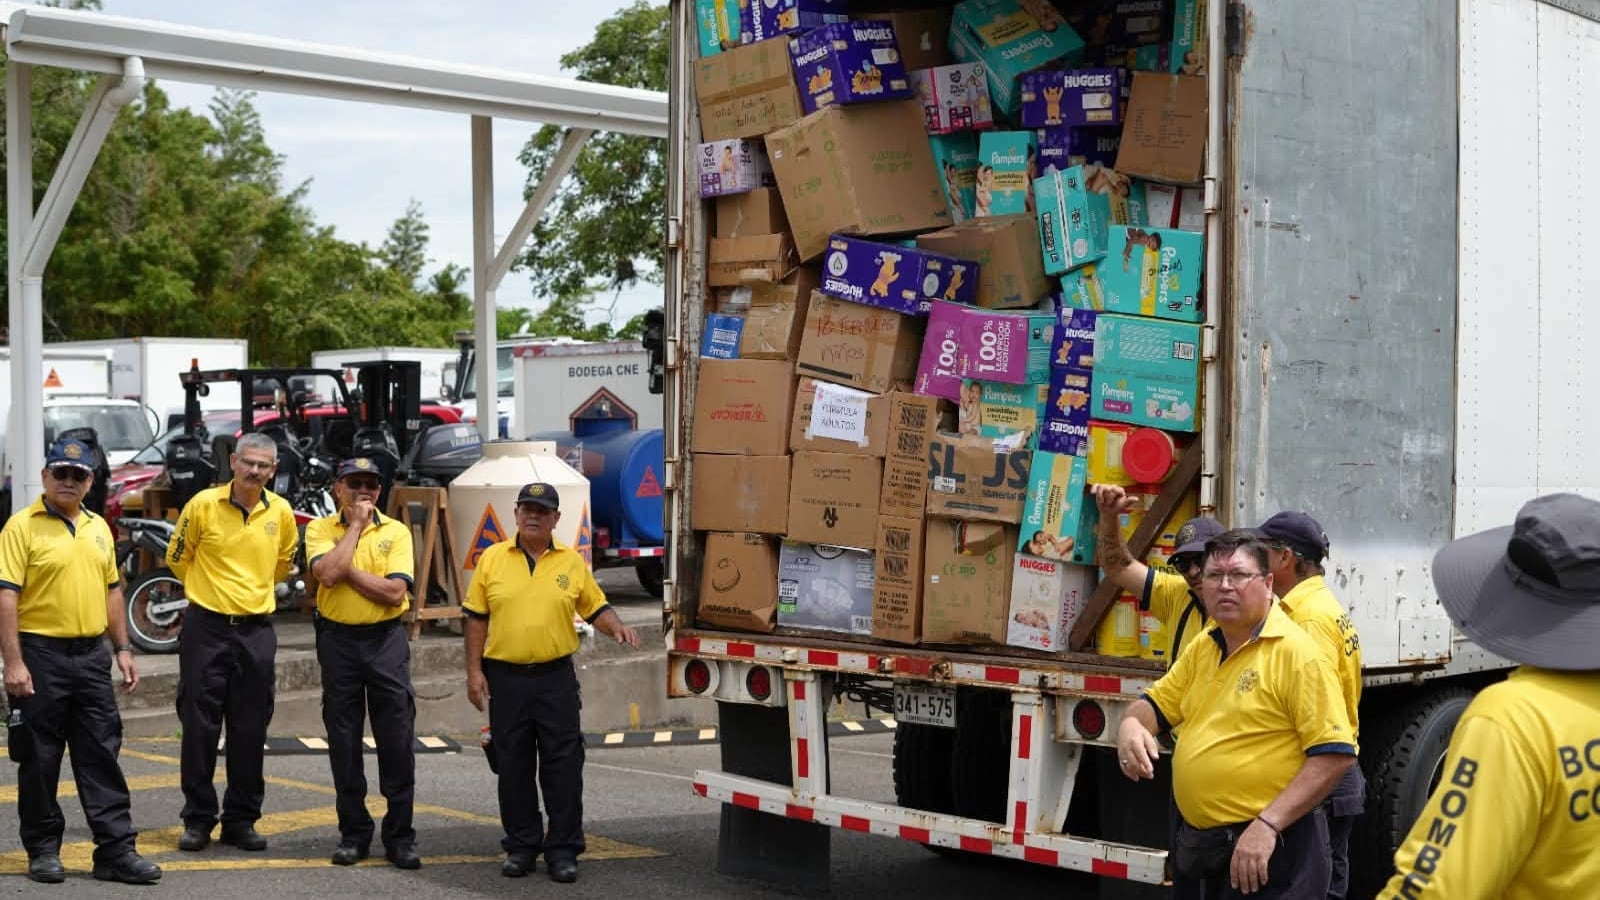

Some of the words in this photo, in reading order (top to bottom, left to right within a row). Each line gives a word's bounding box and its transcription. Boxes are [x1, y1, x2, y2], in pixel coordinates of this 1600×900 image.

[708, 8, 719, 47] Pampers
[852, 28, 893, 41] HUGGIES
[1178, 2, 1193, 46] Pampers
[796, 46, 828, 67] HUGGIES
[1001, 34, 1054, 60] Pampers
[1063, 74, 1112, 88] HUGGIES
[992, 152, 1025, 166] Pampers
[1158, 246, 1177, 304] Pampers
[824, 279, 863, 299] HUGGIES
[936, 329, 956, 376] 100%
[979, 320, 997, 372] 100%
[1001, 321, 1011, 373] PROTECTION
[568, 366, 613, 377] BODEGA
[616, 363, 639, 376] CNE
[984, 385, 1022, 404] Pampers
[1102, 382, 1134, 400] Pampers
[406, 419, 420, 430] CAT
[1050, 421, 1088, 438] HUGGIES
[1027, 479, 1048, 525] Pampers
[1019, 558, 1056, 573] HUGGIES
[896, 693, 953, 718] 341-575
[1392, 757, 1478, 900] BOMBE
